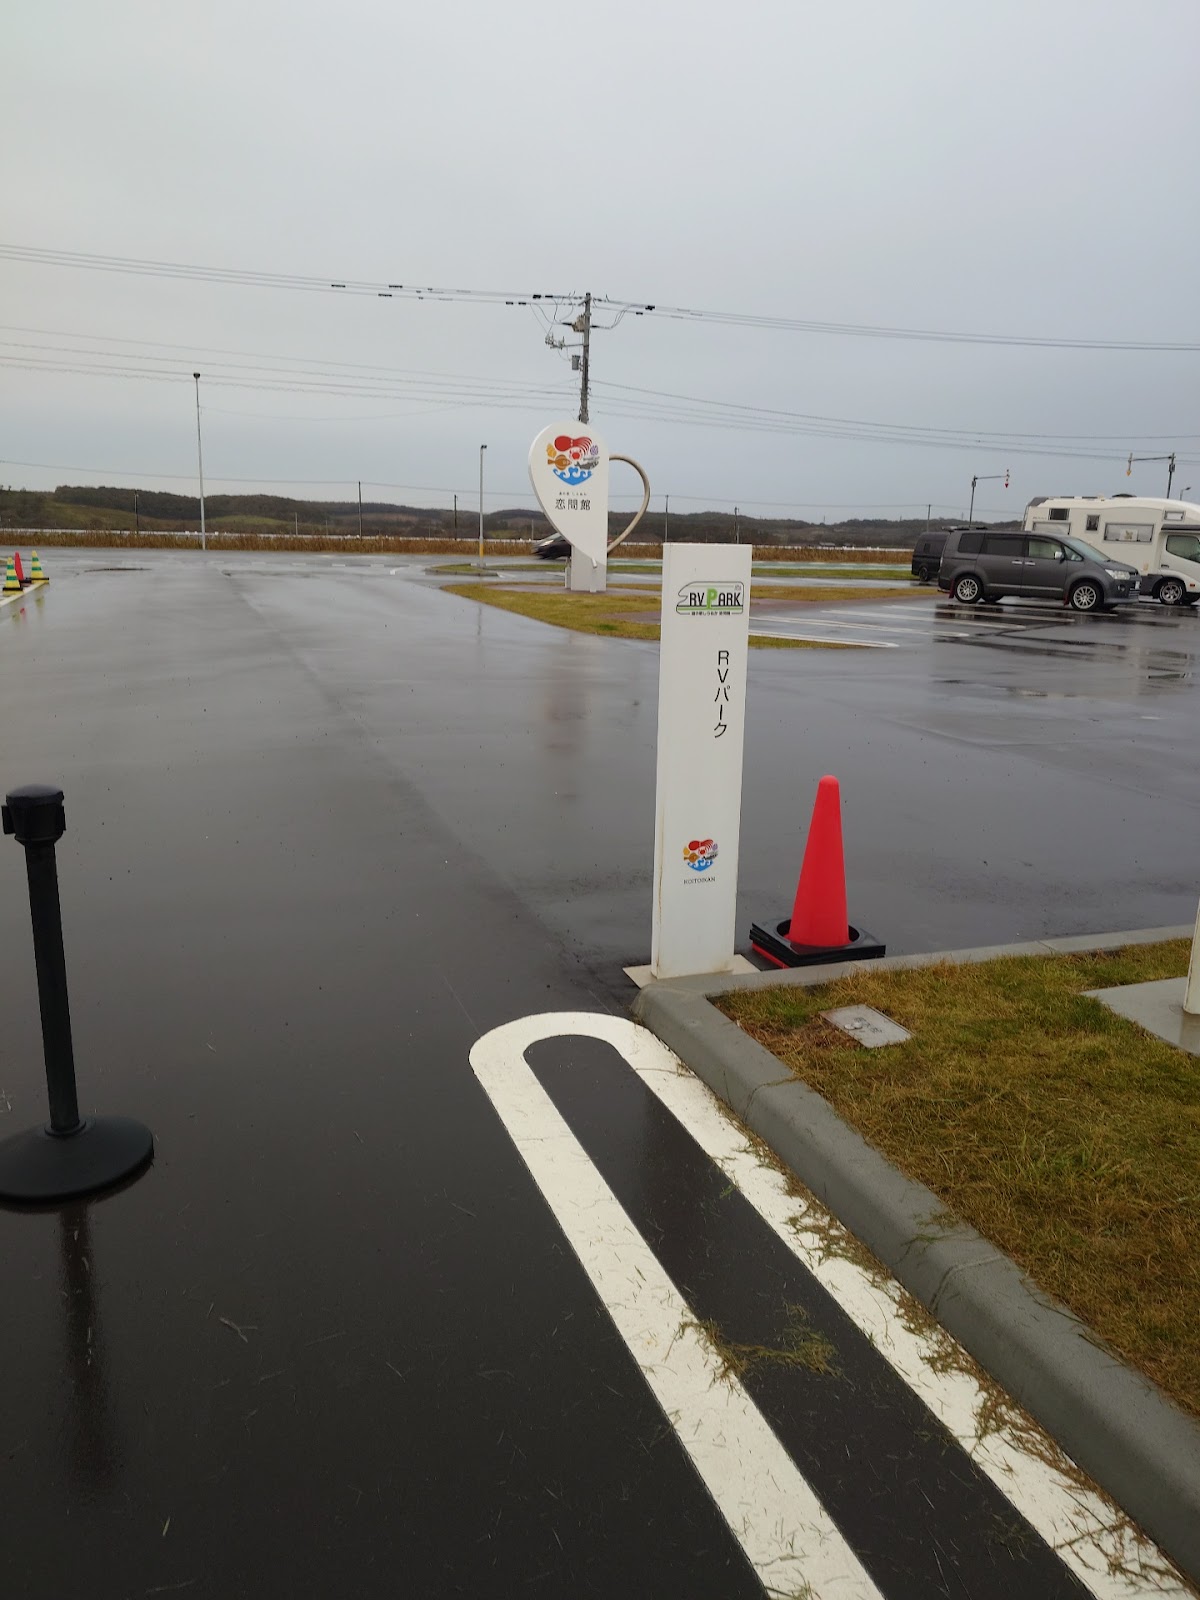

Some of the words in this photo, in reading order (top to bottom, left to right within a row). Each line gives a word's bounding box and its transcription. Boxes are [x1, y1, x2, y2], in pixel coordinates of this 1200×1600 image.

[555, 498, 591, 511] 恋問館
[689, 592, 705, 606] RV
[706, 588, 741, 609] PARK
[714, 650, 731, 739] RVパーク
